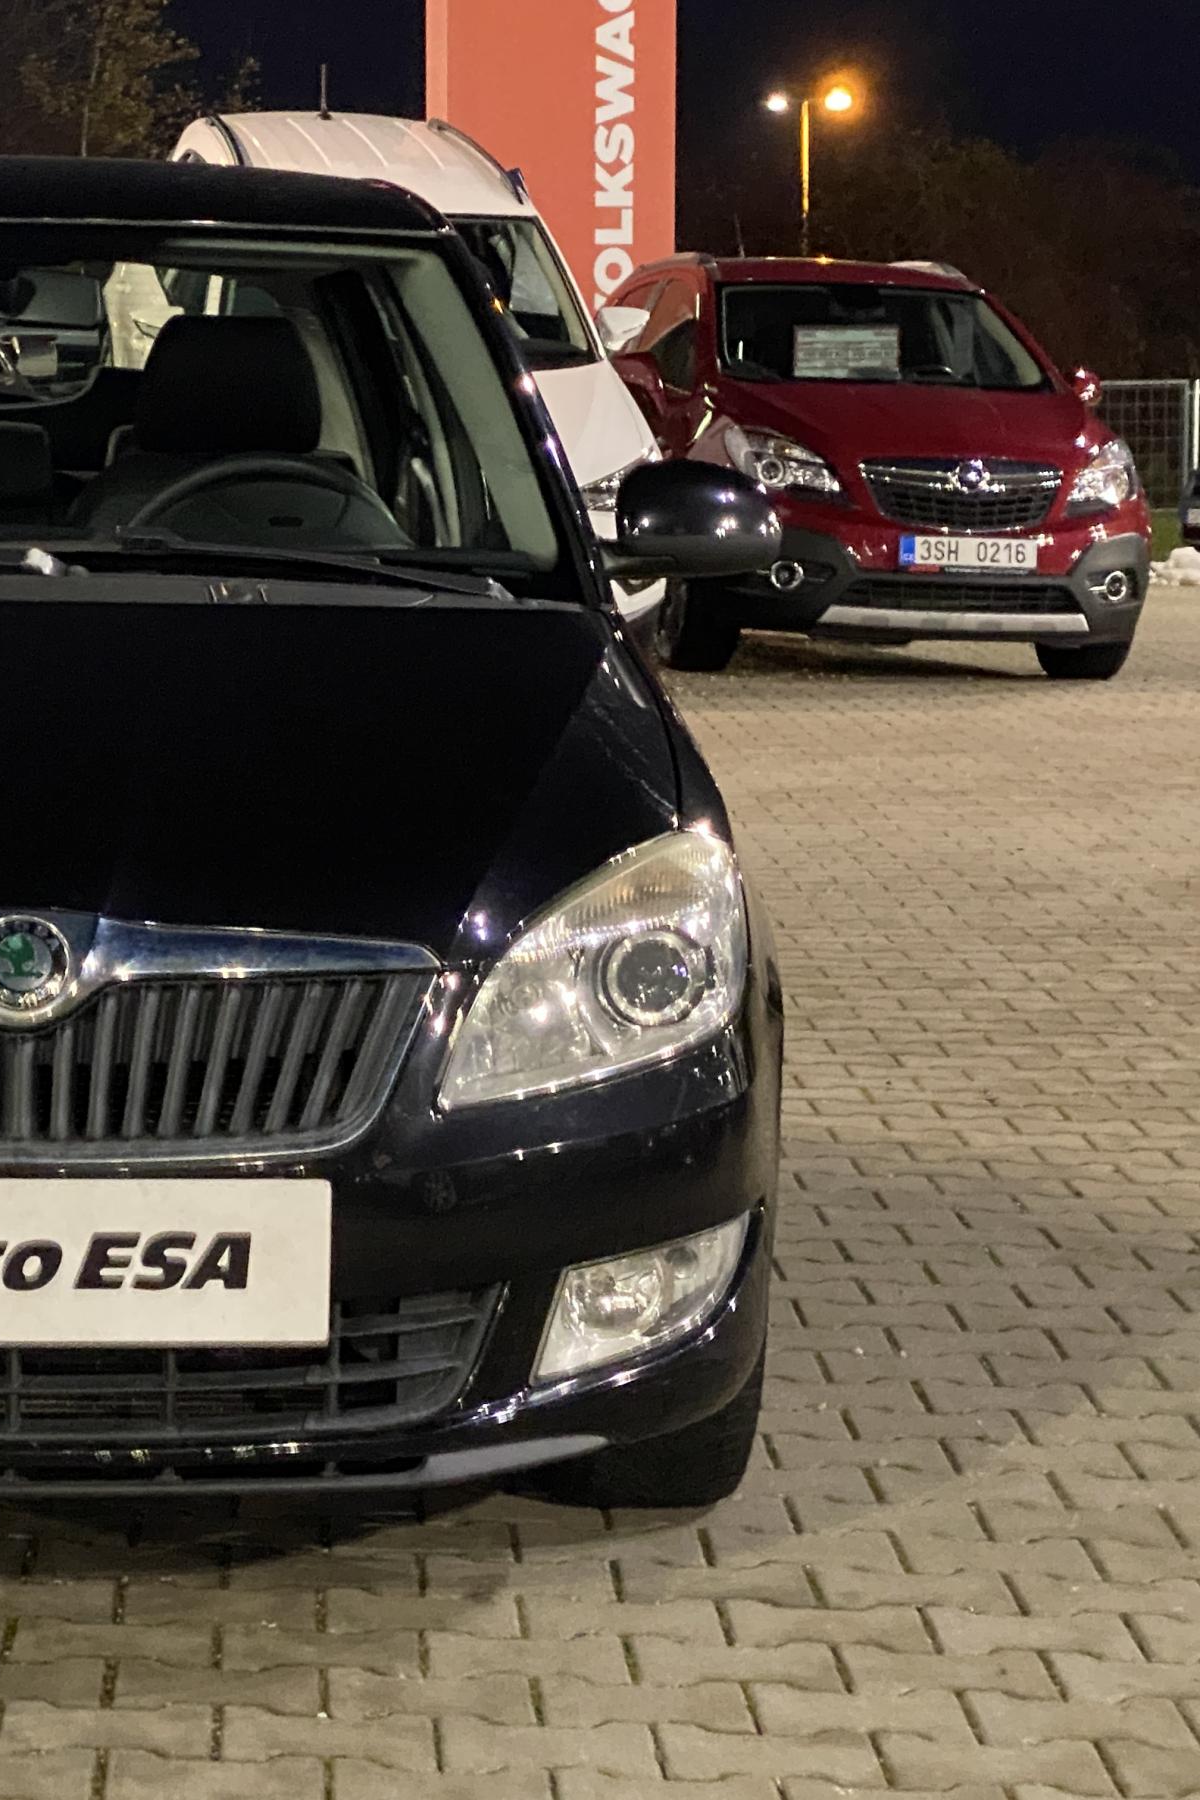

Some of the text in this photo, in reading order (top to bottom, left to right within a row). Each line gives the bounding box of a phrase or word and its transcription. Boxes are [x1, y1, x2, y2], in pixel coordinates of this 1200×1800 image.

[920, 540, 1027, 564] 3SH 0216
[73, 1231, 252, 1290] ESA
